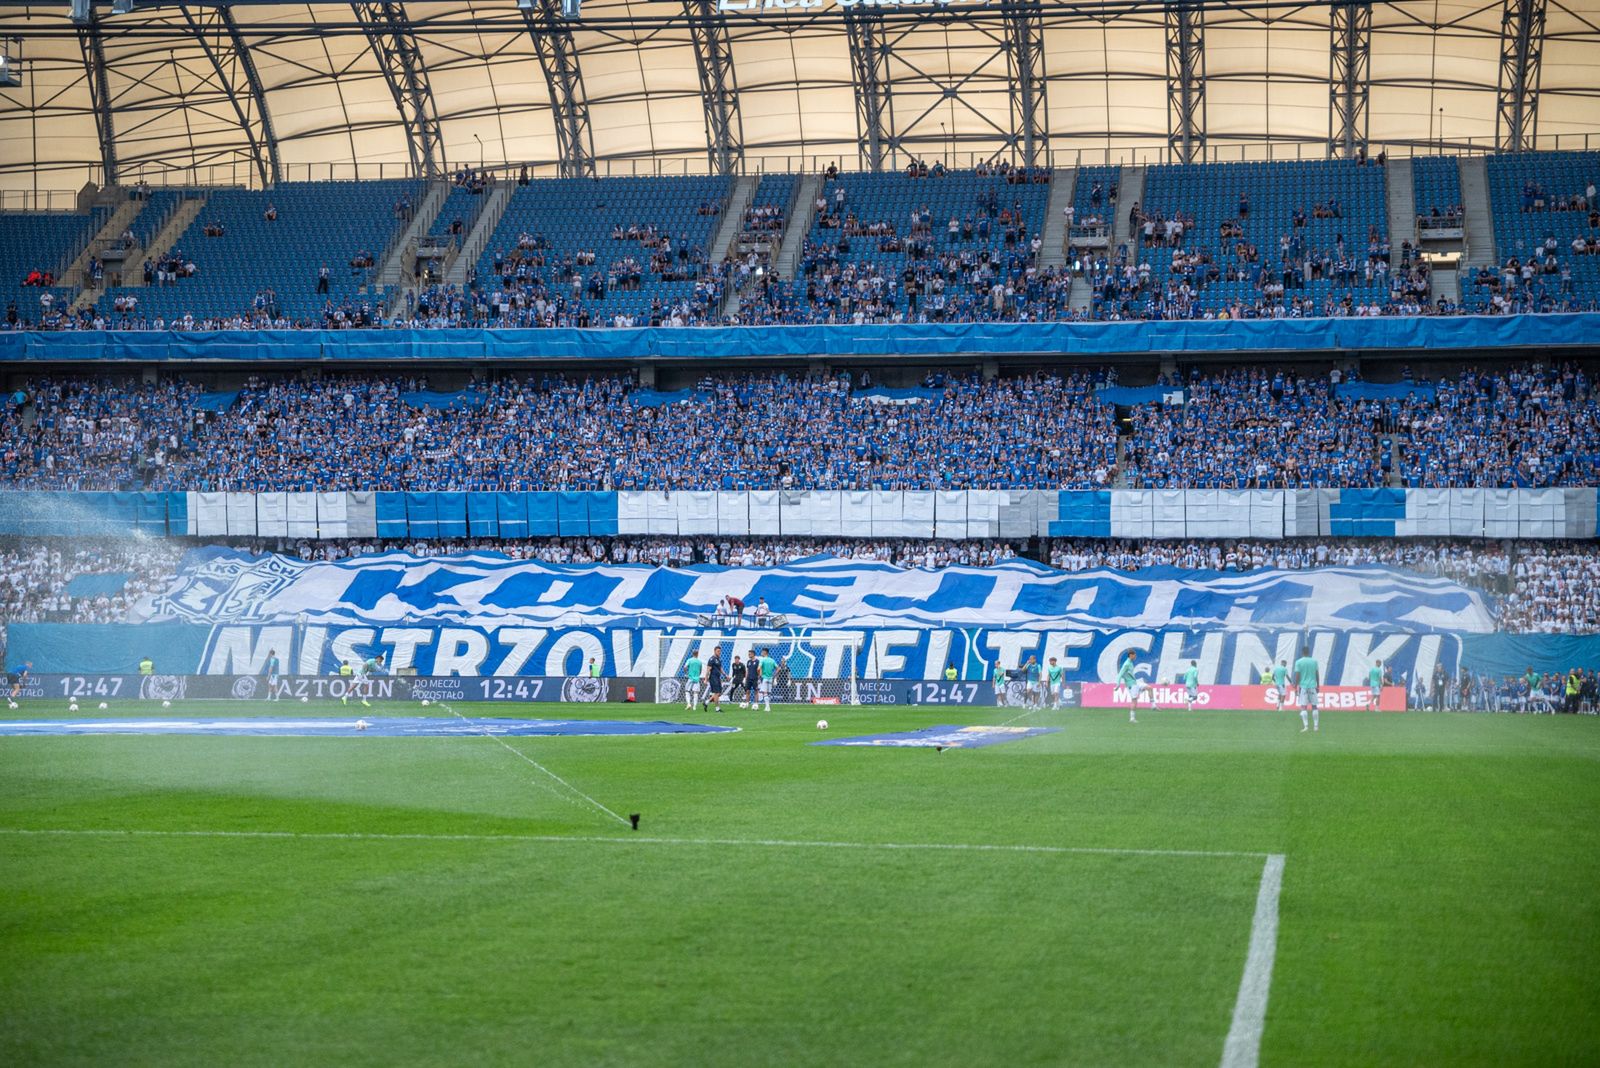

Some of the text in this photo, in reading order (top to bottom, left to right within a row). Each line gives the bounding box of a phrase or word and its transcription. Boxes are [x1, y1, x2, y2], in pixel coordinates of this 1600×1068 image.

[60, 677, 123, 696] 12:47
[430, 679, 461, 689] MECZU
[479, 679, 544, 699] 12:47
[912, 682, 978, 703] 12:47
[412, 690, 464, 700] POZOSTAŁO
